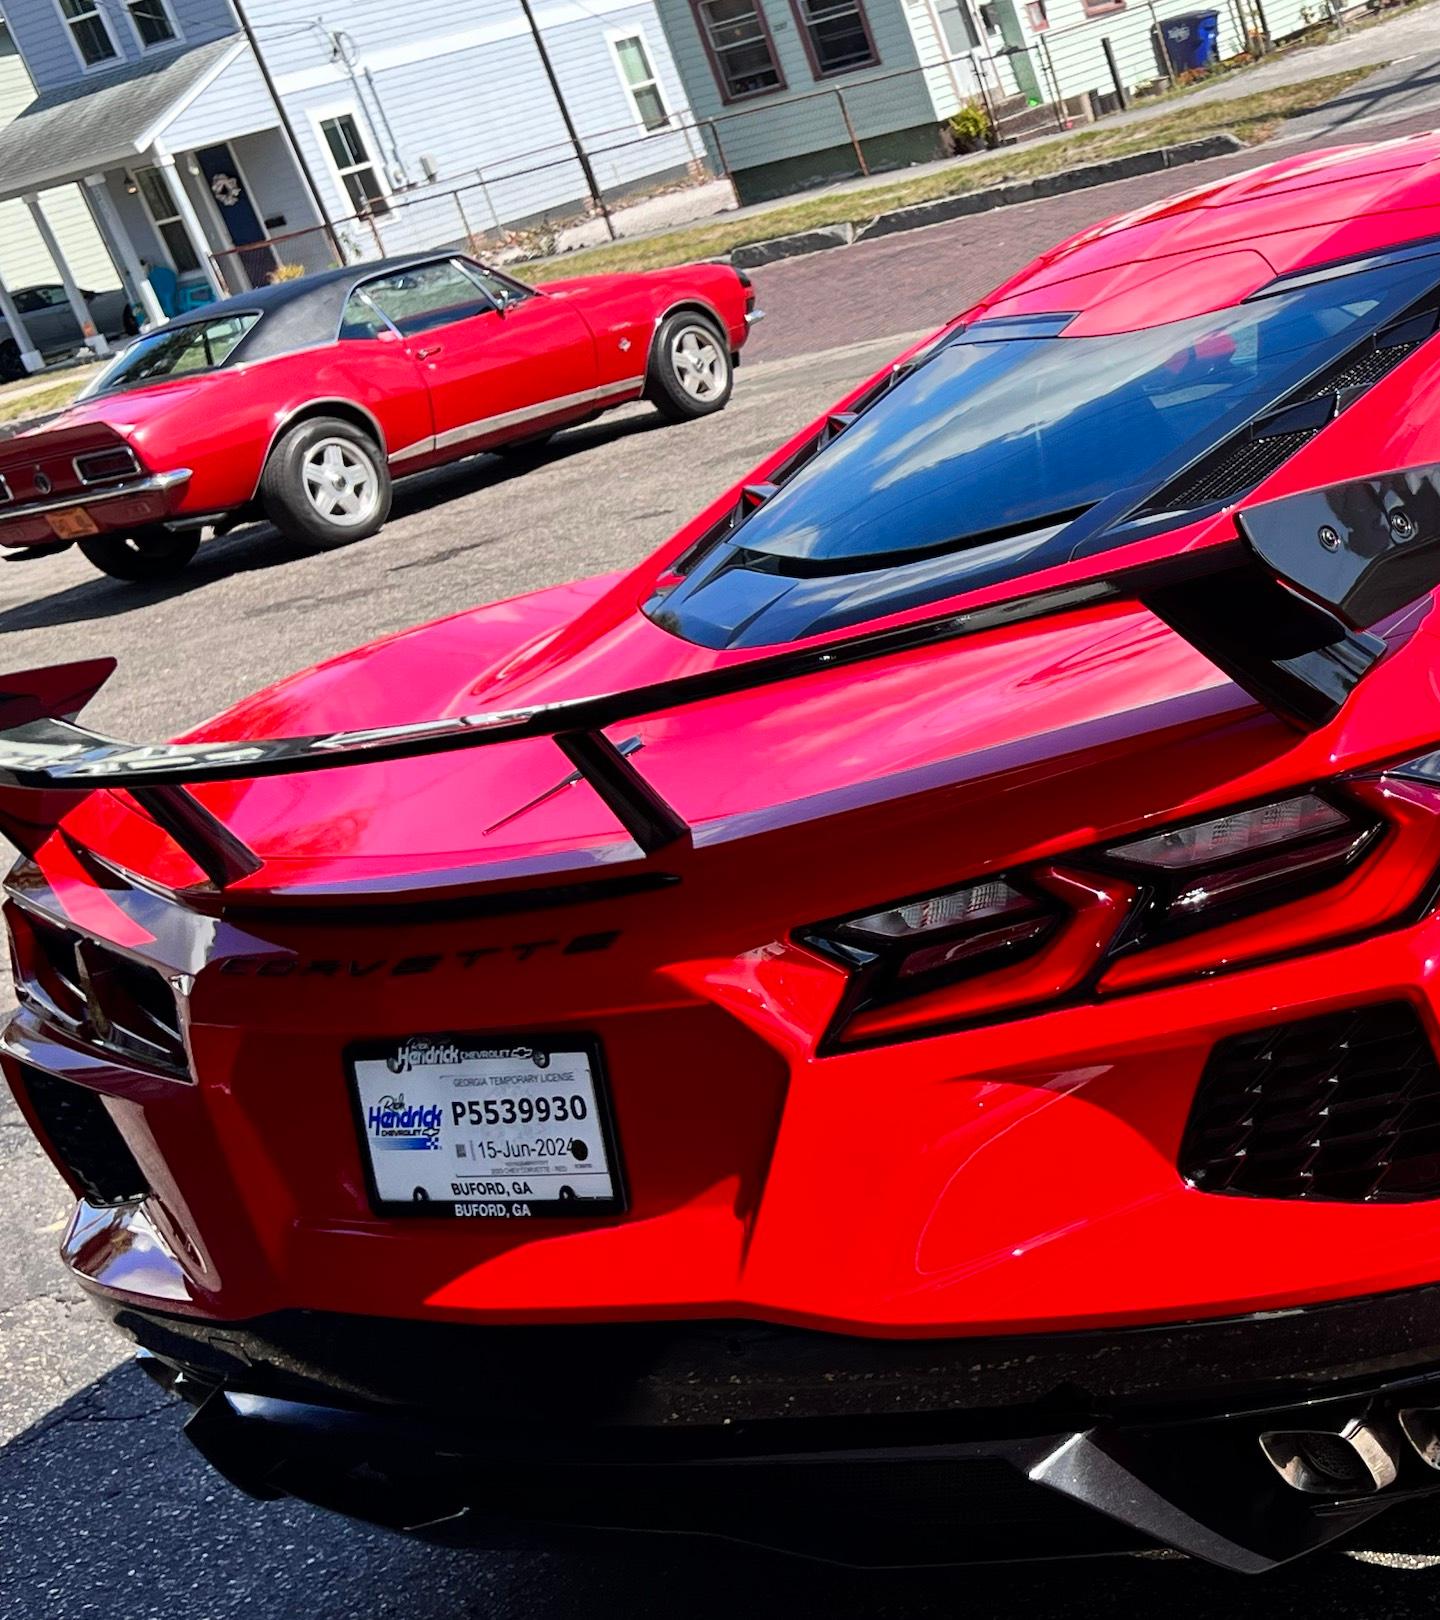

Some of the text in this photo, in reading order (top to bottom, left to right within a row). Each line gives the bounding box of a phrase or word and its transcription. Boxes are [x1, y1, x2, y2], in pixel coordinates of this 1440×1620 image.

[220, 929, 622, 977] CORVETTE
[397, 1044, 510, 1069] Hendrick CHEVROLET
[453, 1071, 575, 1087] GEORGIA TEMPORARY LICENSE
[378, 1093, 405, 1111] Rick
[451, 1094, 587, 1126] P5539930
[368, 1104, 443, 1136] Hendrick
[381, 1129, 422, 1137] CHEVROLET
[478, 1136, 576, 1159] 15-Jun-2024
[451, 1181, 533, 1197] BUFORD, GA
[455, 1203, 532, 1218] BUFORD, GA
